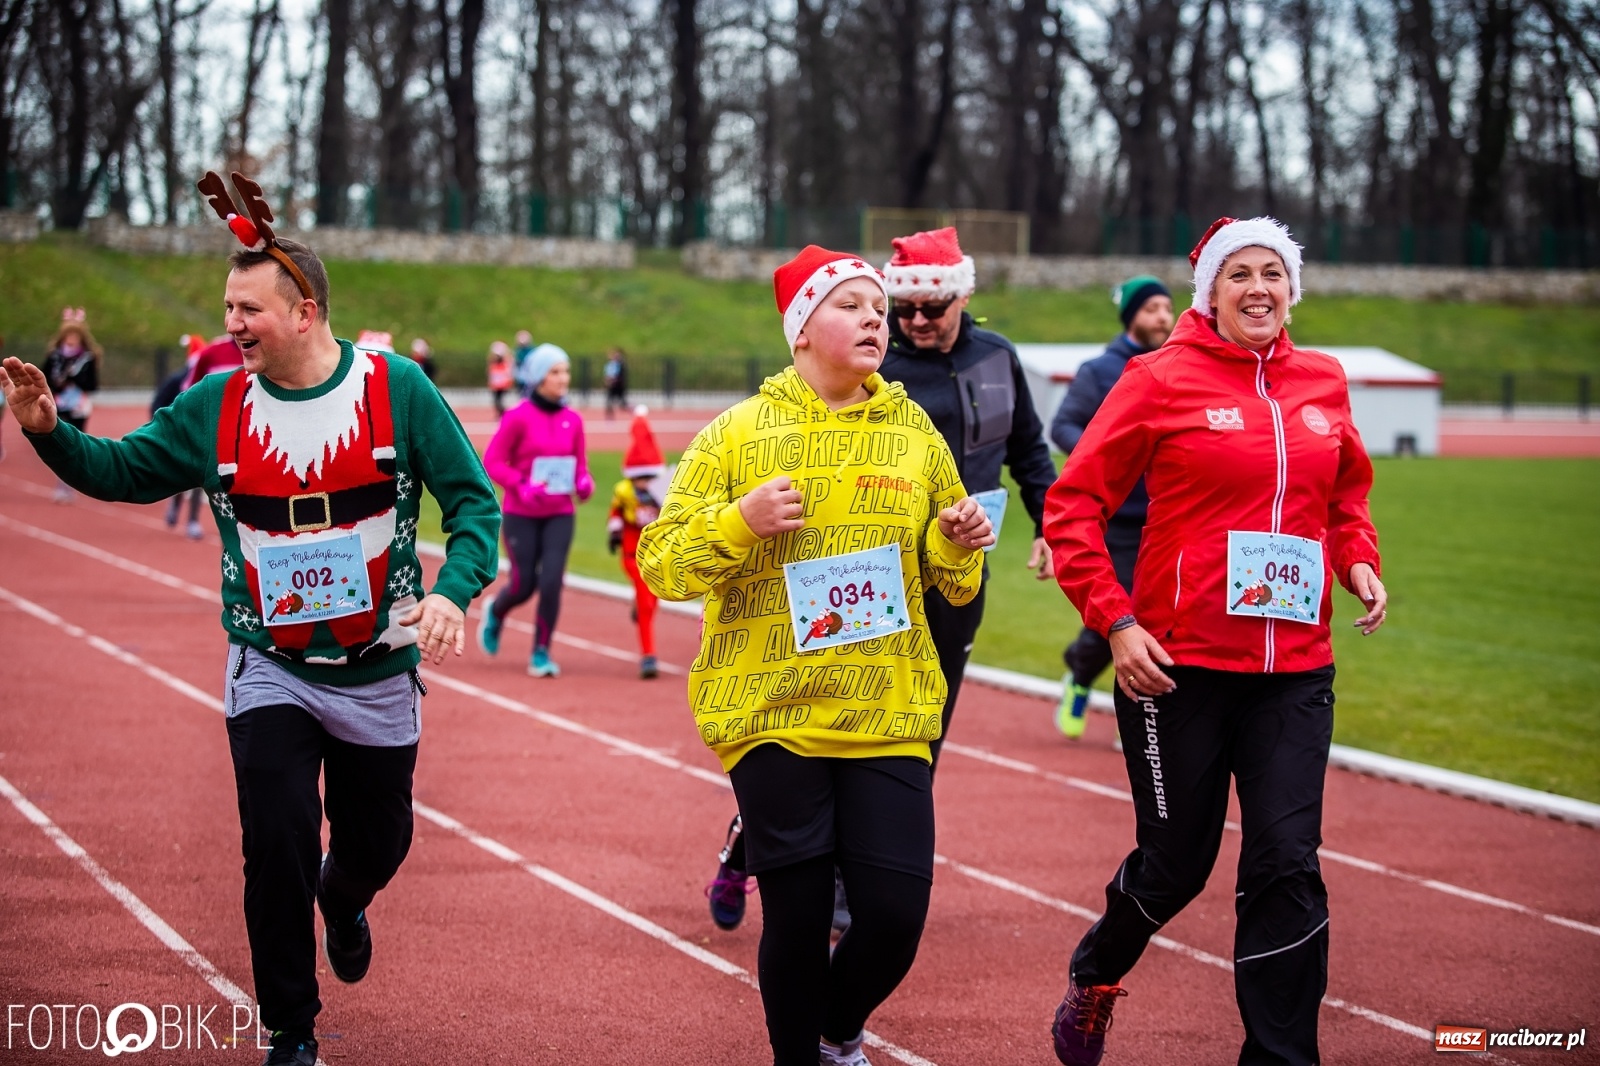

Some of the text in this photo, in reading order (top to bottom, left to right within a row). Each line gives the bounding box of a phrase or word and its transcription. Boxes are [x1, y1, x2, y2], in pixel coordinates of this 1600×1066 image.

[1240, 546, 1266, 557] Bieg
[267, 558, 290, 570] Bieg
[1264, 561, 1300, 586] 048
[291, 567, 335, 590] 002
[799, 573, 827, 588] Bieg
[828, 580, 875, 608] 034
[1137, 696, 1168, 820] smsraciborz.pl
